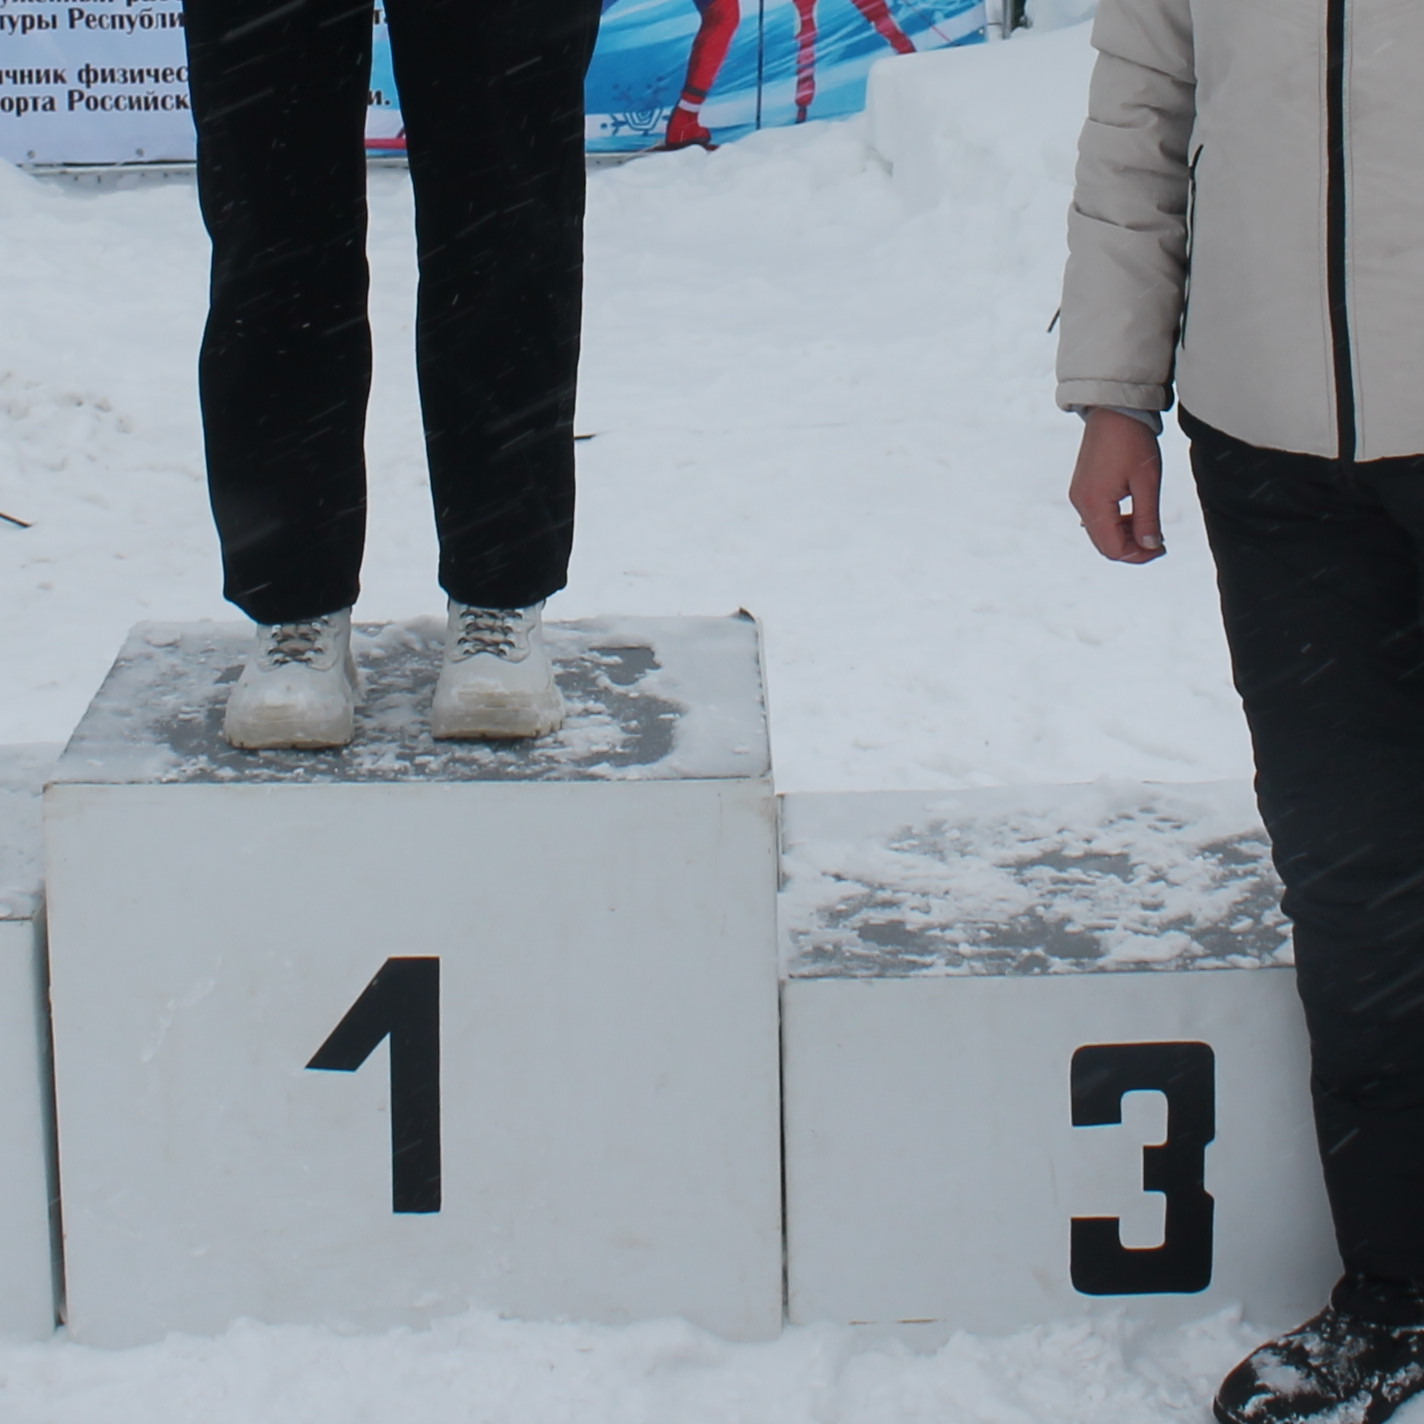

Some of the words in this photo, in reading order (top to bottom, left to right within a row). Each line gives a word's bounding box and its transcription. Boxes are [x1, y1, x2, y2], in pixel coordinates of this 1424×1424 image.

[68, 89, 190, 112] Российск
[303, 956, 442, 1214] 1
[1070, 1041, 1215, 1295] 3
